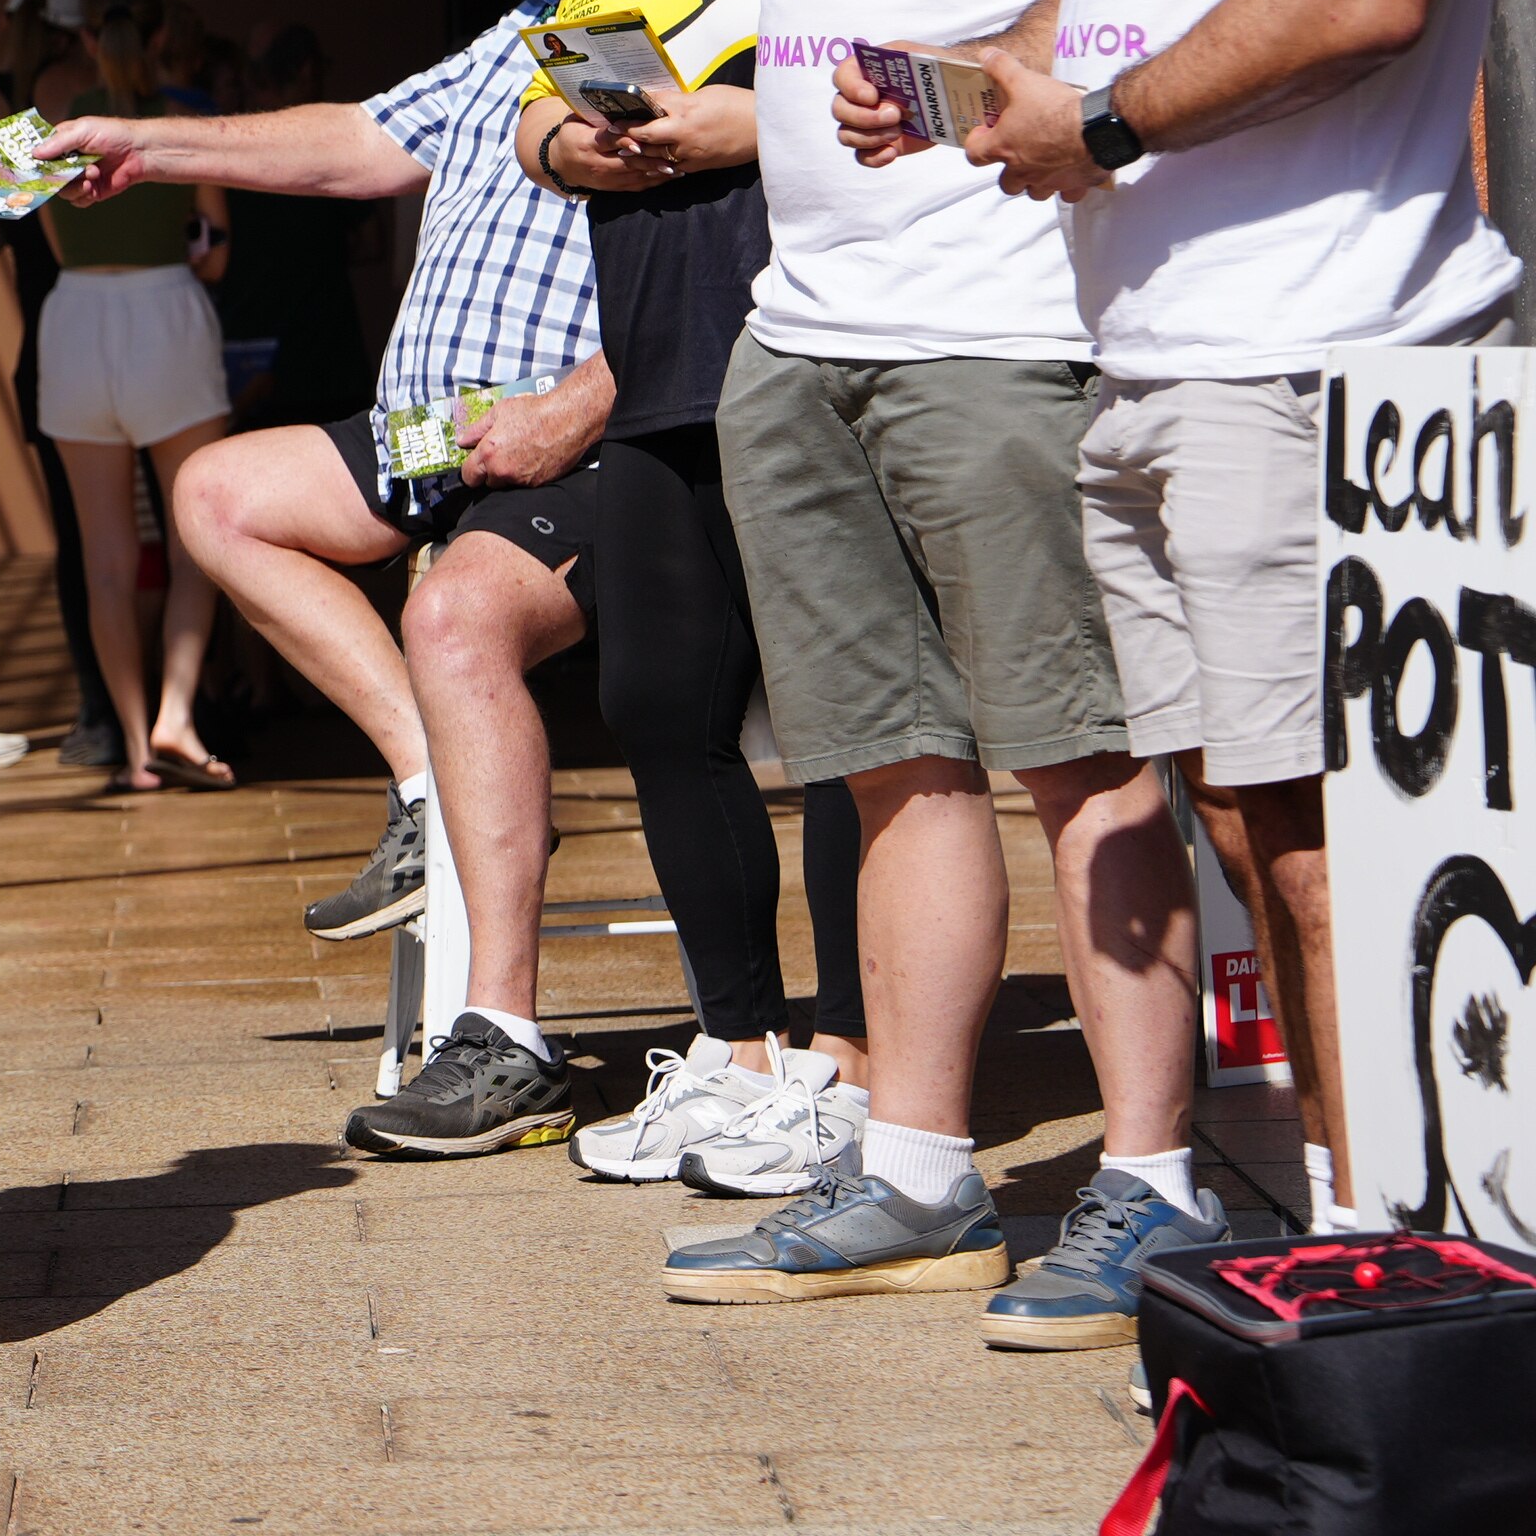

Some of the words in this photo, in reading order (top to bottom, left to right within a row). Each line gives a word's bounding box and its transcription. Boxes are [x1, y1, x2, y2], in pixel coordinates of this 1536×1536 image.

[884, 58, 901, 88] PETER
[894, 57, 915, 97] STYLES
[918, 63, 947, 138] RICHARDSON
[1323, 554, 1536, 812] POT
